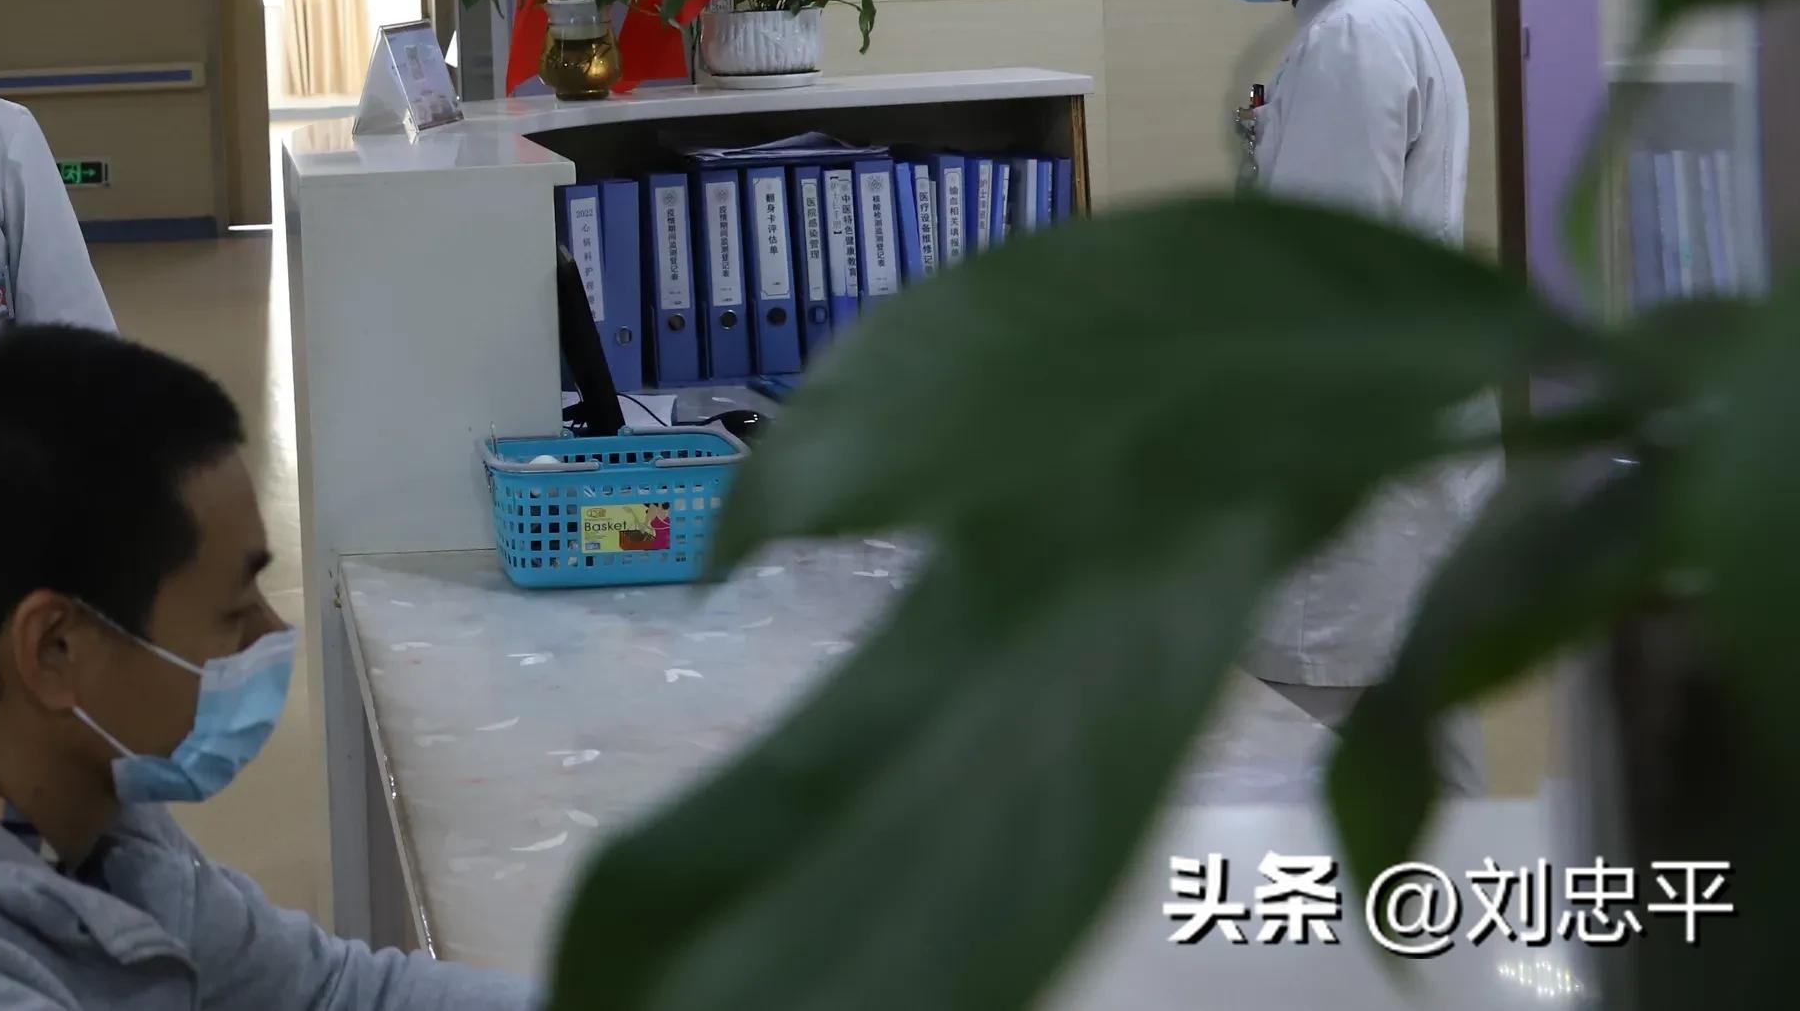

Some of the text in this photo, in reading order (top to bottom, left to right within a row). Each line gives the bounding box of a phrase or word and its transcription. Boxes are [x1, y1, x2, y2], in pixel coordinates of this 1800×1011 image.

[765, 192, 780, 255] 翻身卡评估单
[806, 196, 820, 260] 医院感染管理
[841, 194, 857, 277] 中医特色健康教育
[584, 520, 627, 532] Basket
